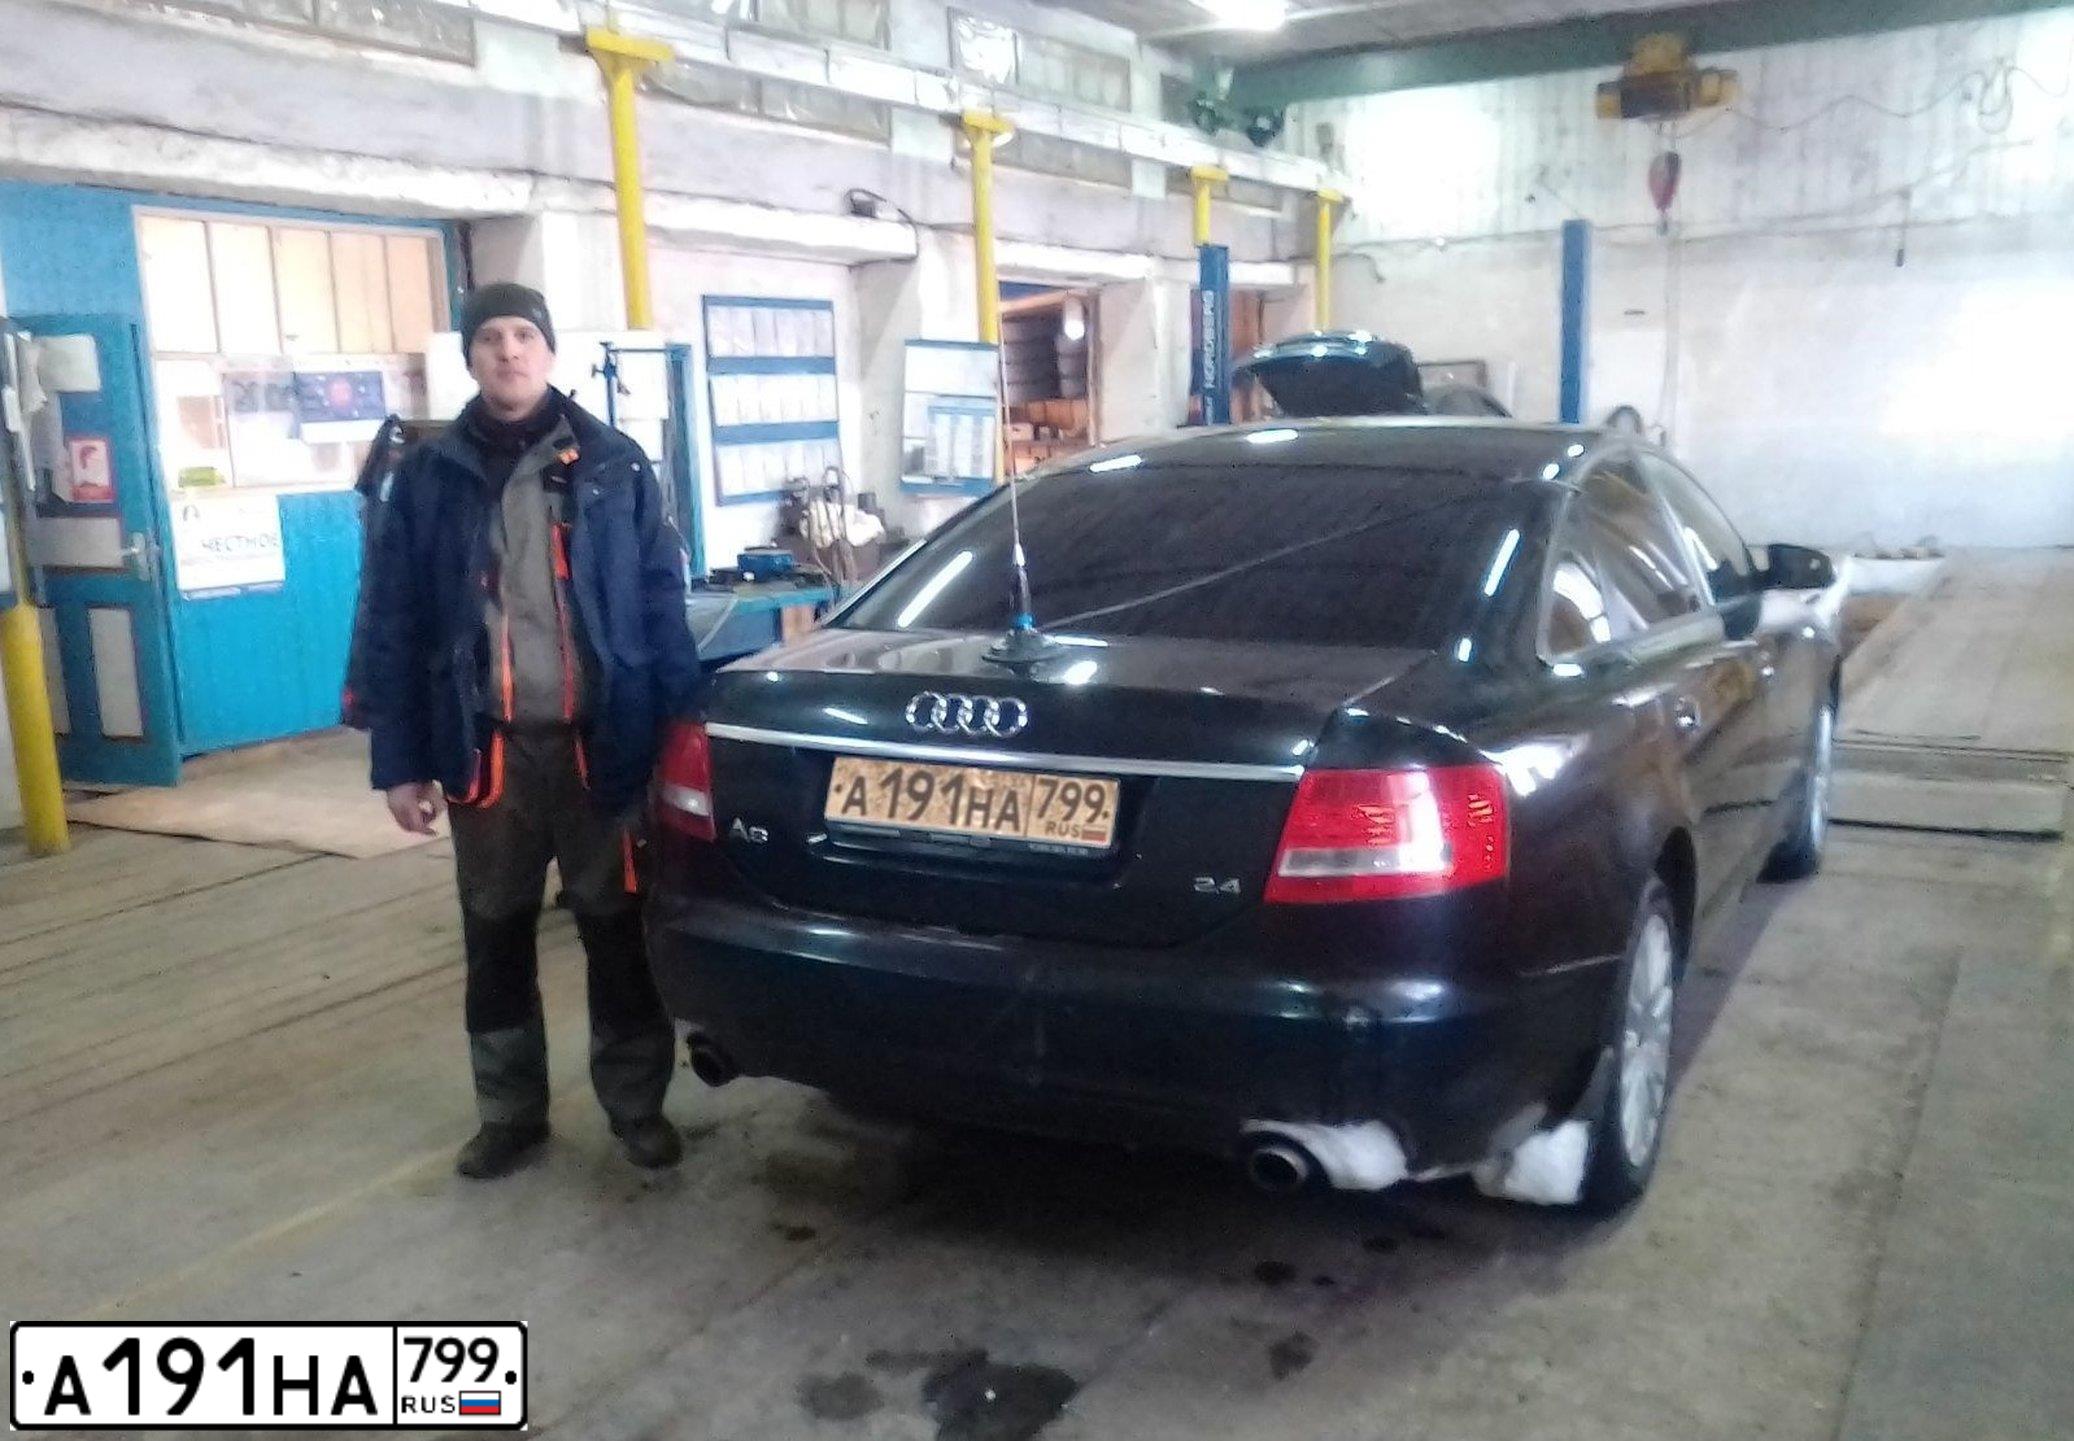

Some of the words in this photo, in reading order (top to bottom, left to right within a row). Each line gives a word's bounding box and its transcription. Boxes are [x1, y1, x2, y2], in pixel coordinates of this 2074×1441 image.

[841, 767, 1021, 832] А191НА
[1036, 777, 1106, 824] 799
[1044, 822, 1081, 839] RUS
